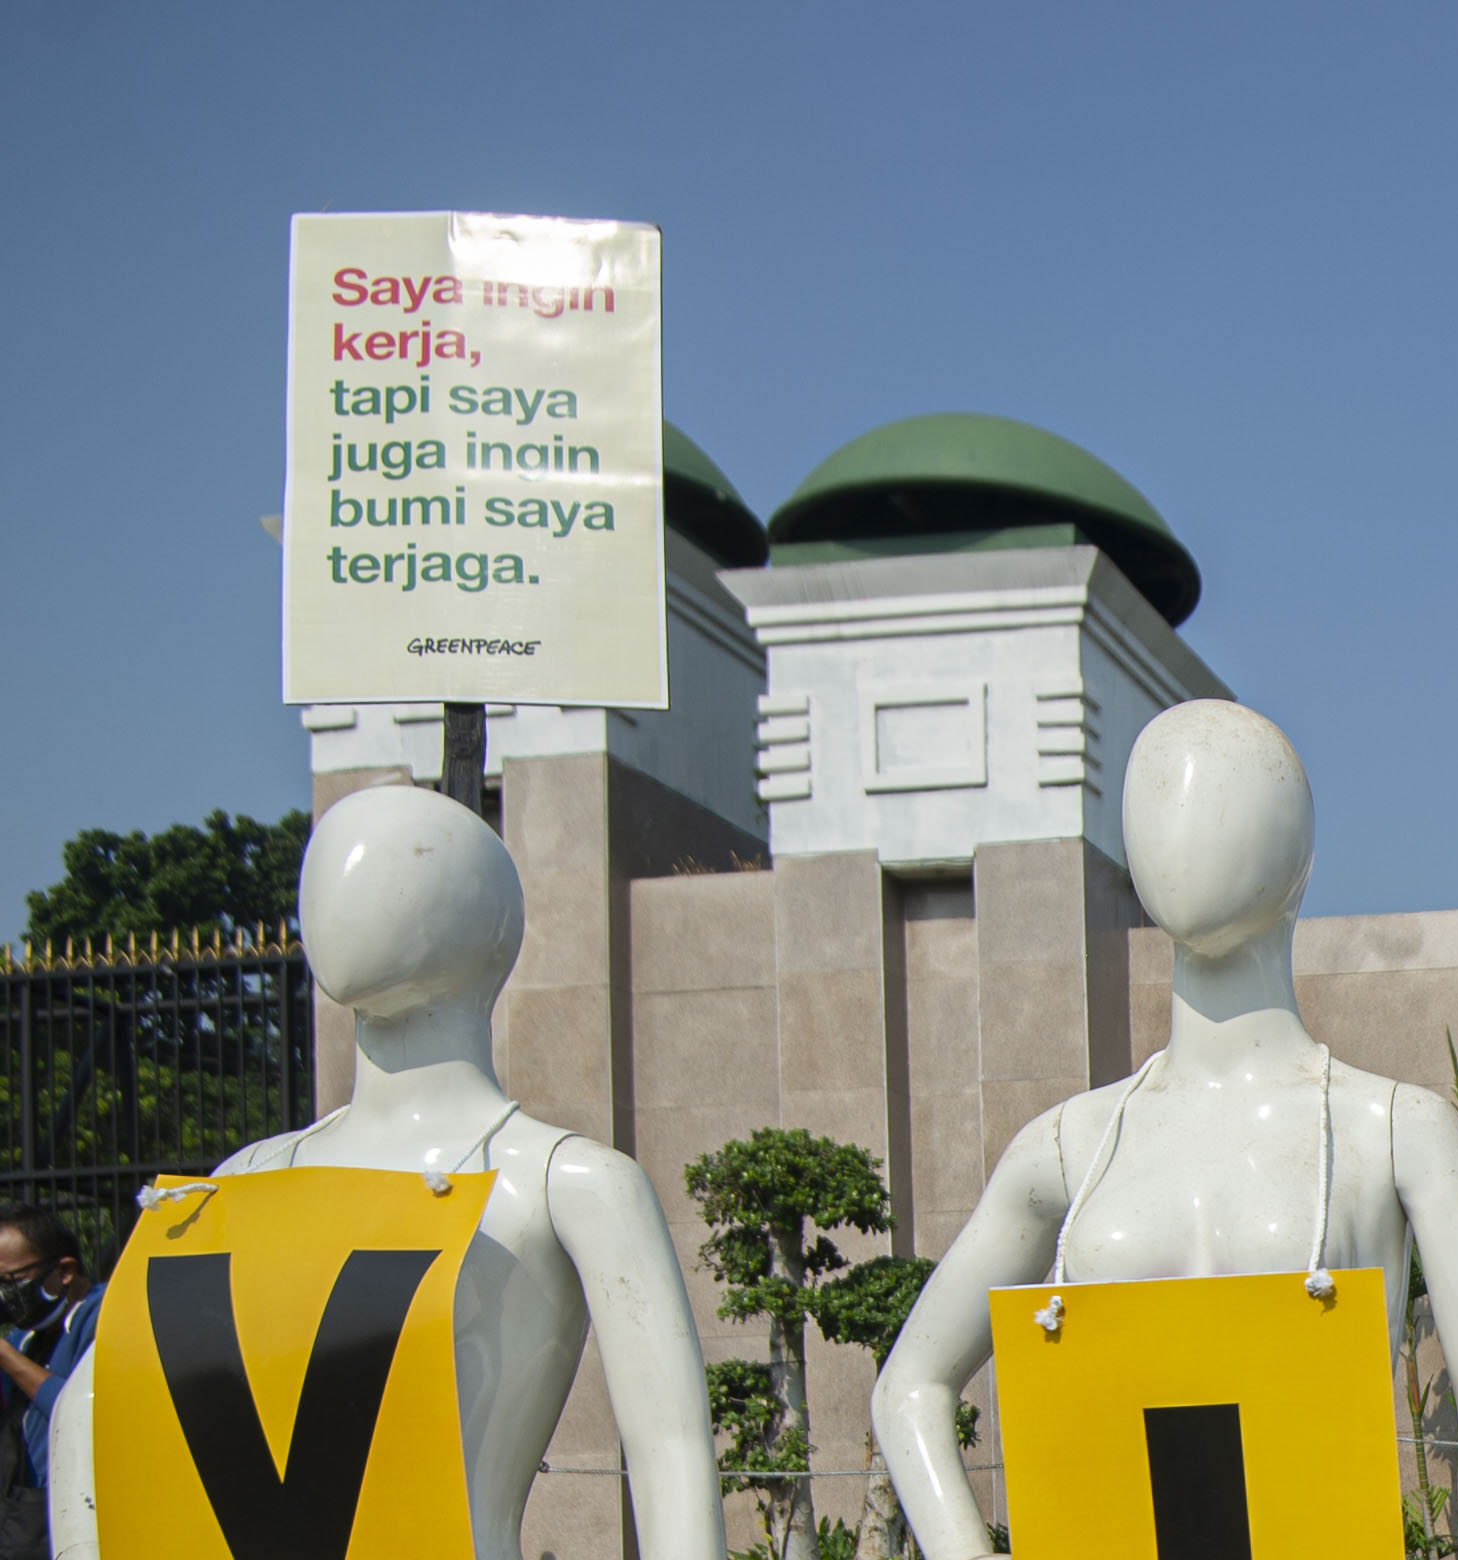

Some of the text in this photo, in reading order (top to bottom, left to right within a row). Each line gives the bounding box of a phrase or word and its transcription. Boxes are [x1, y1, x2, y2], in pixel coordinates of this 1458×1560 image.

[332, 267, 463, 314] Saya
[333, 320, 481, 368] kerja,
[330, 374, 578, 425] tapi saya
[328, 430, 600, 480] juga ingin
[329, 486, 615, 537] bumi saya
[327, 542, 540, 592] terjaga.
[407, 637, 542, 656] GREENPEACE
